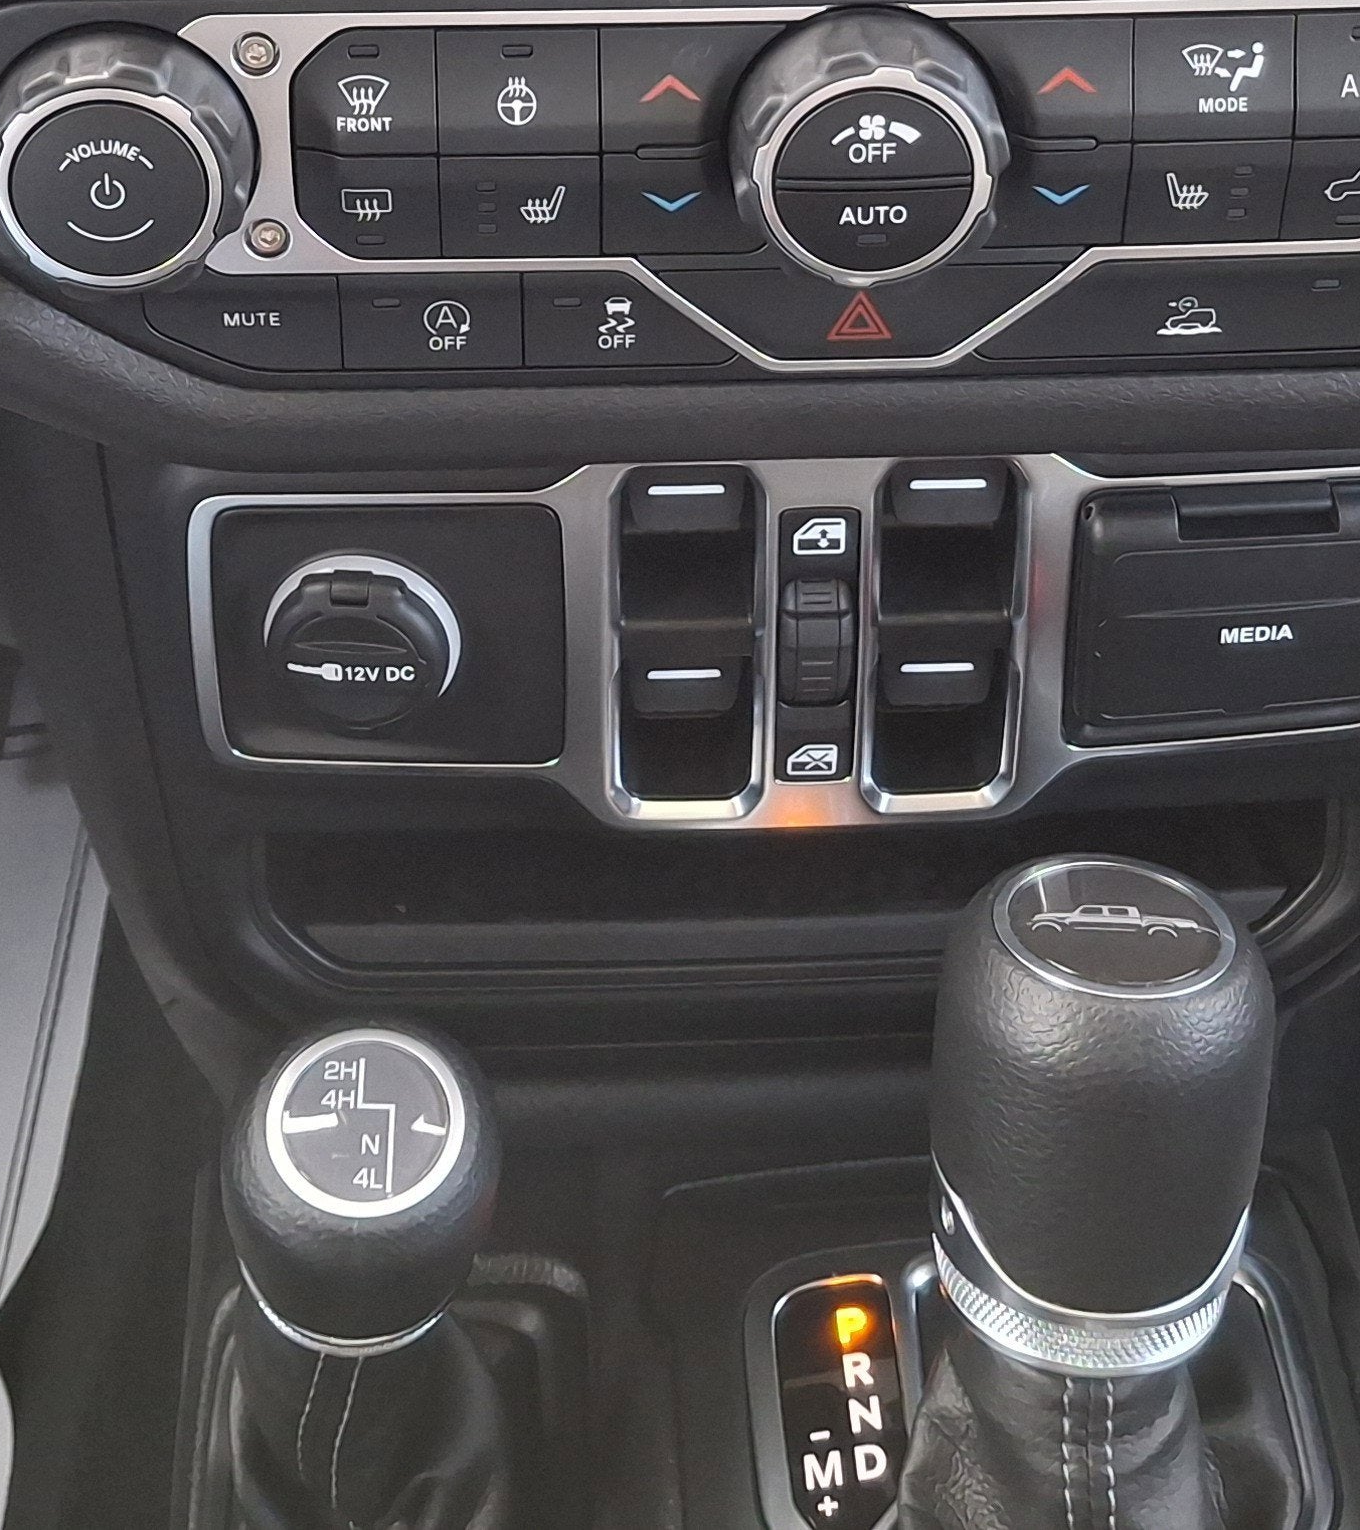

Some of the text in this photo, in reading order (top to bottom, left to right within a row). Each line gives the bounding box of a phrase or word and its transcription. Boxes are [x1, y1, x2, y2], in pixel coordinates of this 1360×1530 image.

[1197, 96, 1249, 115] MODE
[336, 115, 393, 133] FRONT
[64, 143, 141, 165] VOLUME
[847, 142, 897, 165] OFF
[839, 205, 908, 227] AUTO
[222, 310, 282, 329] MUTE
[428, 335, 468, 352] OFF
[597, 333, 637, 350] OFF
[1219, 624, 1294, 646] MEDIA
[343, 664, 416, 683] 12V DC
[323, 1060, 358, 1081] 2H
[320, 1089, 356, 1111] 4H
[360, 1133, 380, 1156] N
[352, 1167, 384, 1190] 4L
[835, 1306, 868, 1345] P
[841, 1351, 875, 1389] R
[847, 1394, 884, 1435] N
[802, 1449, 845, 1492] M
[853, 1443, 888, 1482] D
